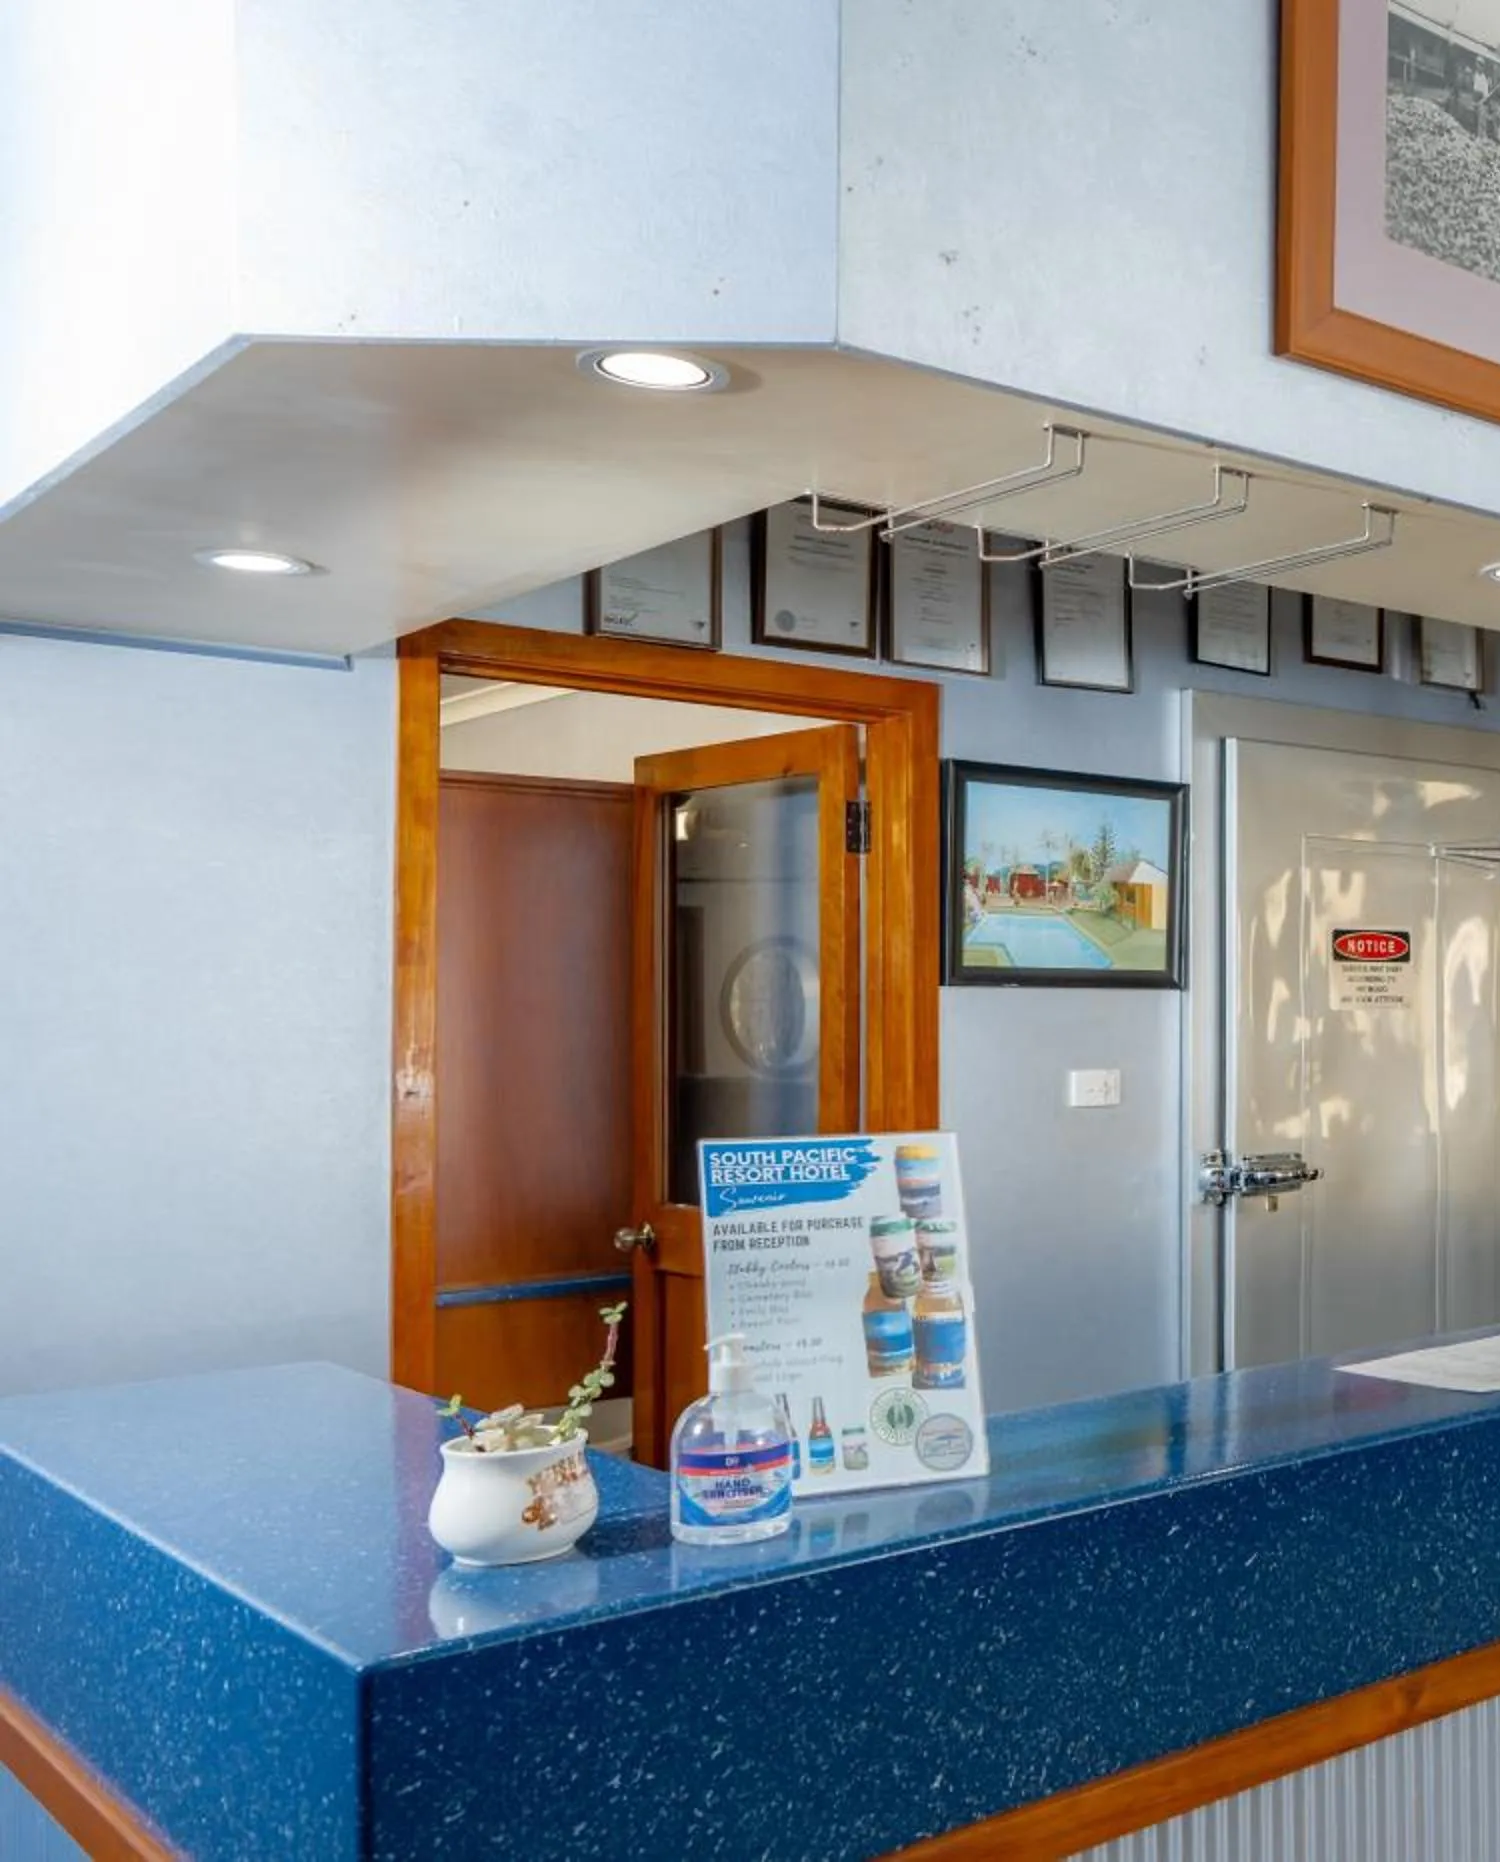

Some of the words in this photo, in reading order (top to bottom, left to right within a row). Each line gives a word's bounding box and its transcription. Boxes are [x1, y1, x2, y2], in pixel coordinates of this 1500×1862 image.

[1347, 940, 1396, 953] NOTICE
[709, 1151, 776, 1168] SOUTH
[781, 1147, 857, 1164] PACIFIC
[711, 1166, 785, 1184] RESORT
[789, 1164, 850, 1182] HOTEL
[713, 1221, 778, 1237] AVAILABLE
[781, 1219, 804, 1233] FOR
[807, 1216, 864, 1231] PURCHASE
[712, 1237, 746, 1253] FROM
[749, 1234, 810, 1251] RECEPTION
[715, 1477, 751, 1490] HAND
